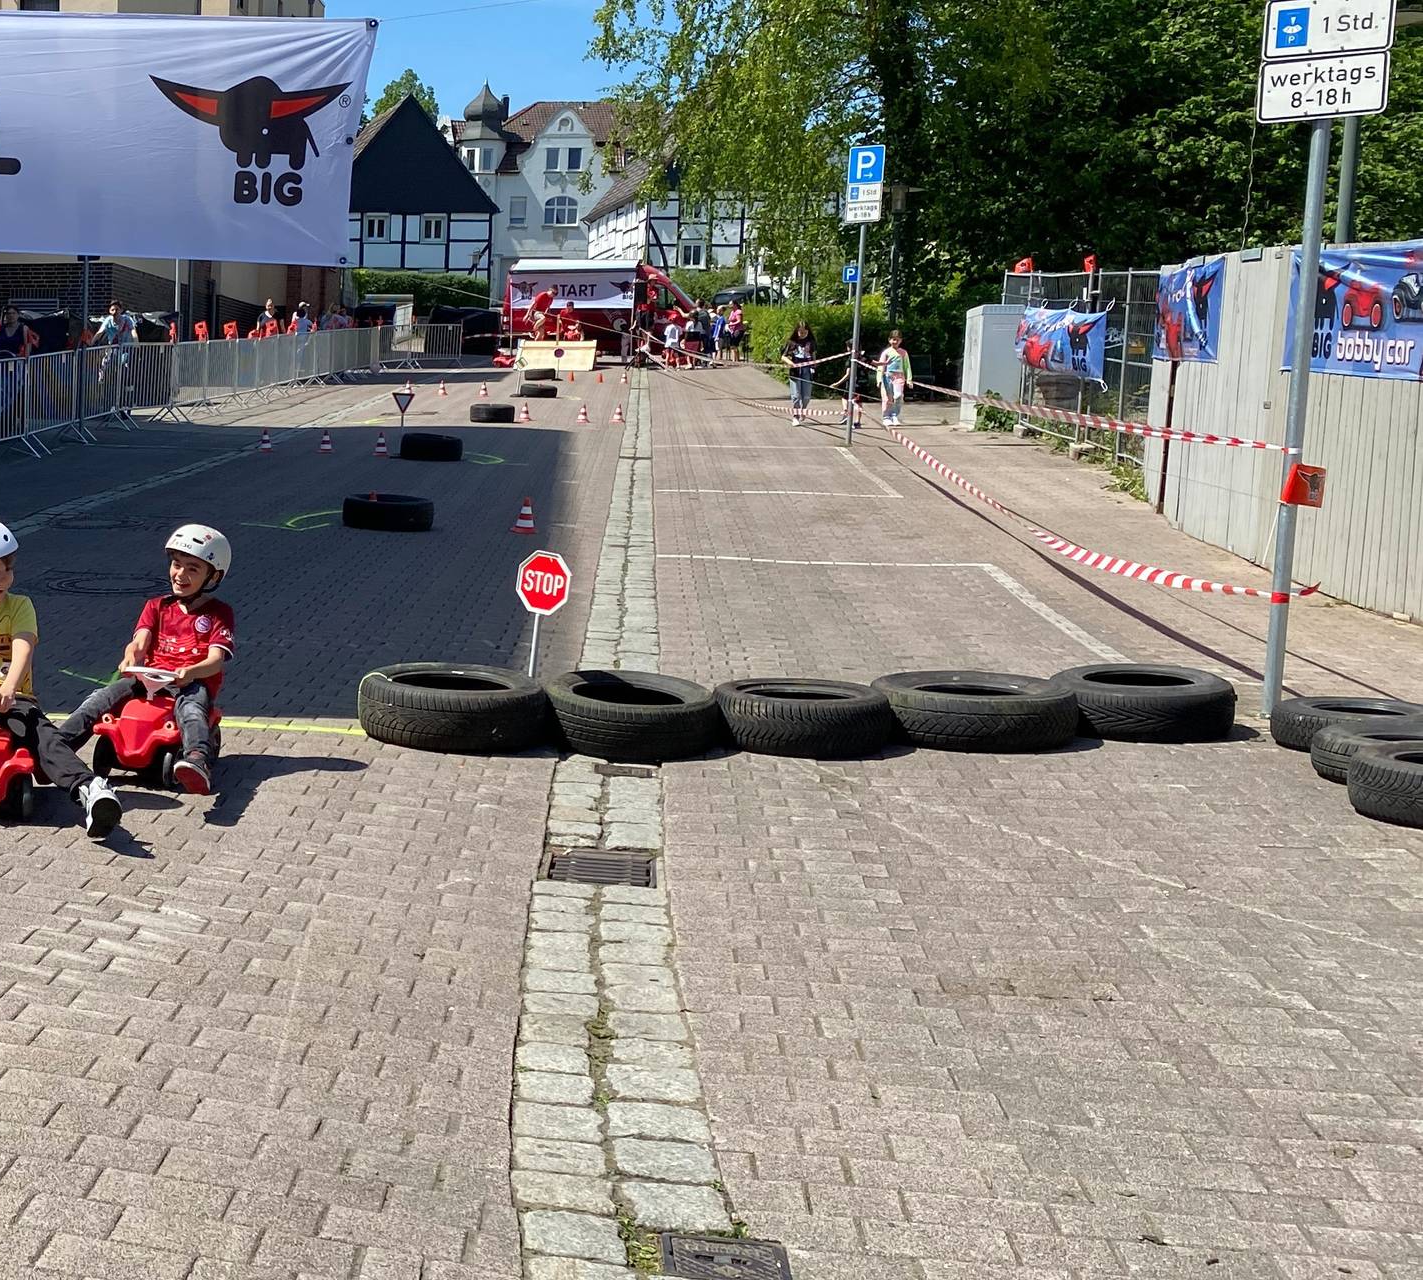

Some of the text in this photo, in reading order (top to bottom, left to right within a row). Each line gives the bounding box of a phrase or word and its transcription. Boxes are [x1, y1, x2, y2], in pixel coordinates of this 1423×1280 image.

[1322, 12, 1379, 33] 1 Std.
[1288, 35, 1296, 44] P
[1270, 66, 1376, 88] werktags
[856, 151, 876, 179] P
[234, 170, 303, 207] BIG
[846, 268, 855, 280] P
[554, 283, 597, 297] TART
[1312, 330, 1415, 372] BIG bobby car
[1071, 356, 1088, 373] BIG
[523, 569, 564, 597] STOP
